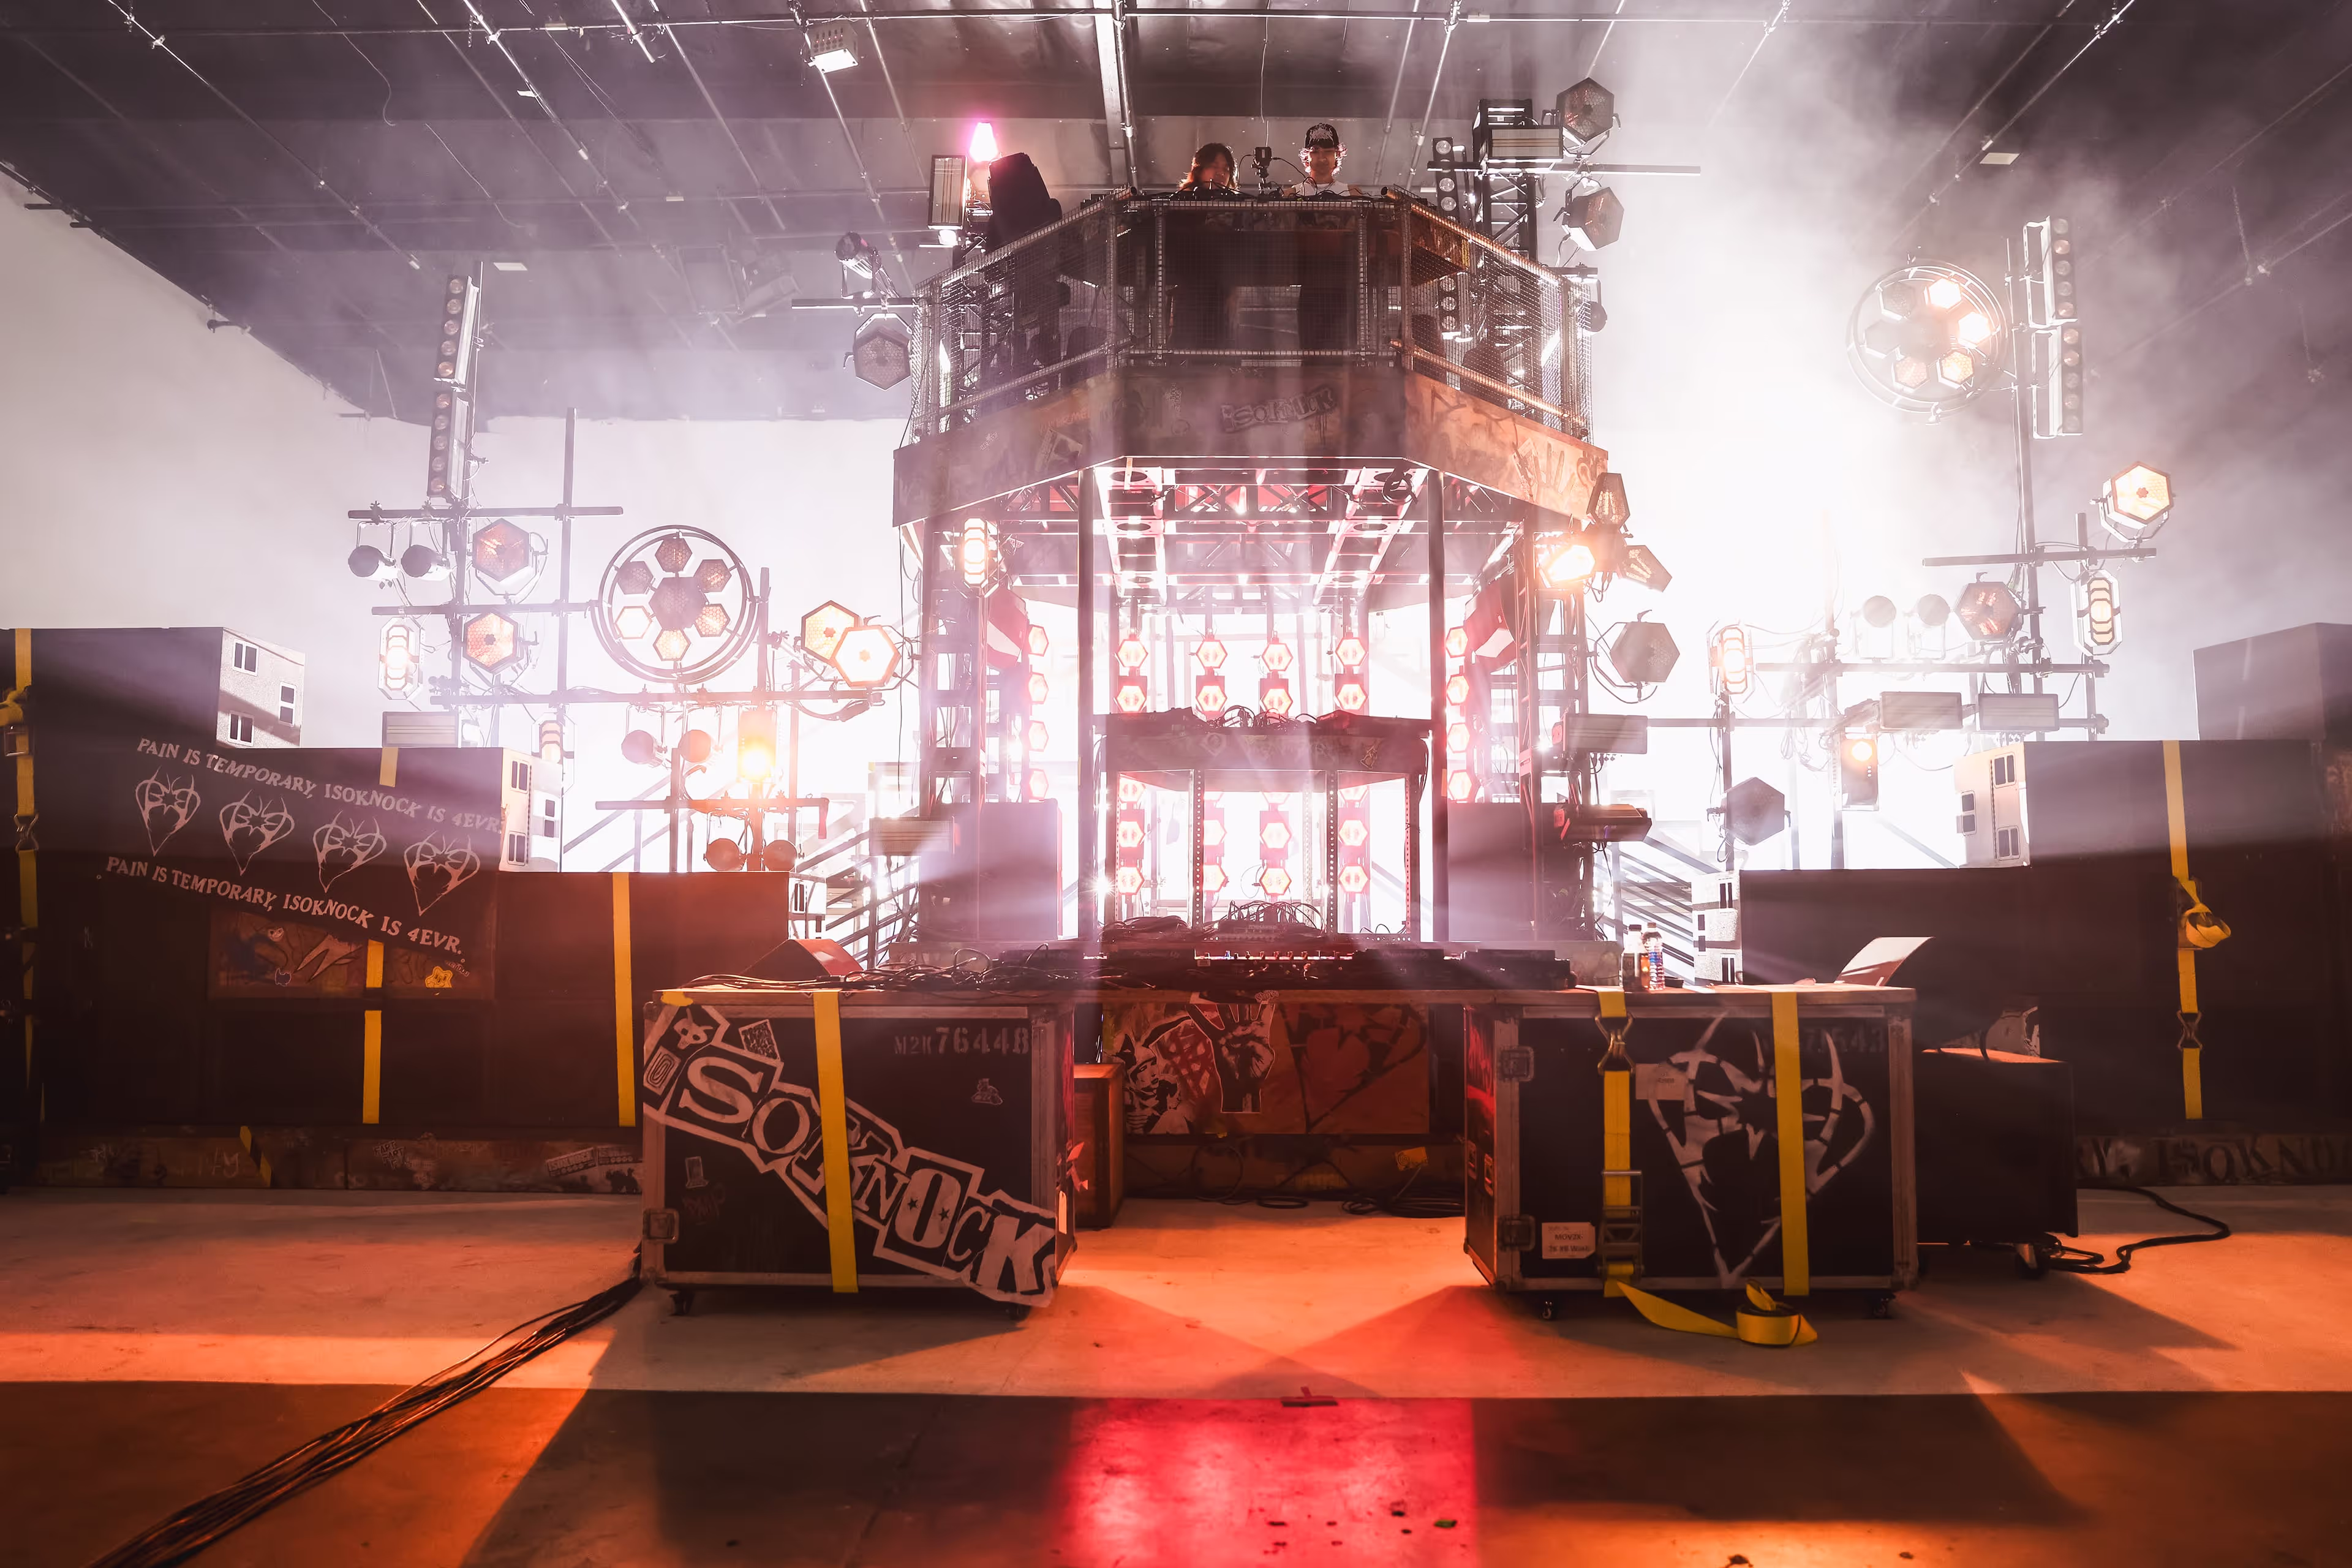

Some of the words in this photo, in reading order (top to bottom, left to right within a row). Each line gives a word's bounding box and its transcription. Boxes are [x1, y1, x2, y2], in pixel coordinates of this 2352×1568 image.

[137, 738, 179, 758] PAIN
[183, 748, 201, 765] IS
[206, 753, 317, 799] TEMPORARY,
[324, 784, 422, 818] ISOKNOCK
[427, 806, 447, 823] IS
[106, 856, 149, 876] PAIN
[153, 866, 167, 883] IS
[172, 870, 277, 912] TEMPORARY,
[283, 894, 375, 929] ISOKNOCK
[380, 916, 402, 936] IS
[407, 928, 462, 955] 4EVR.
